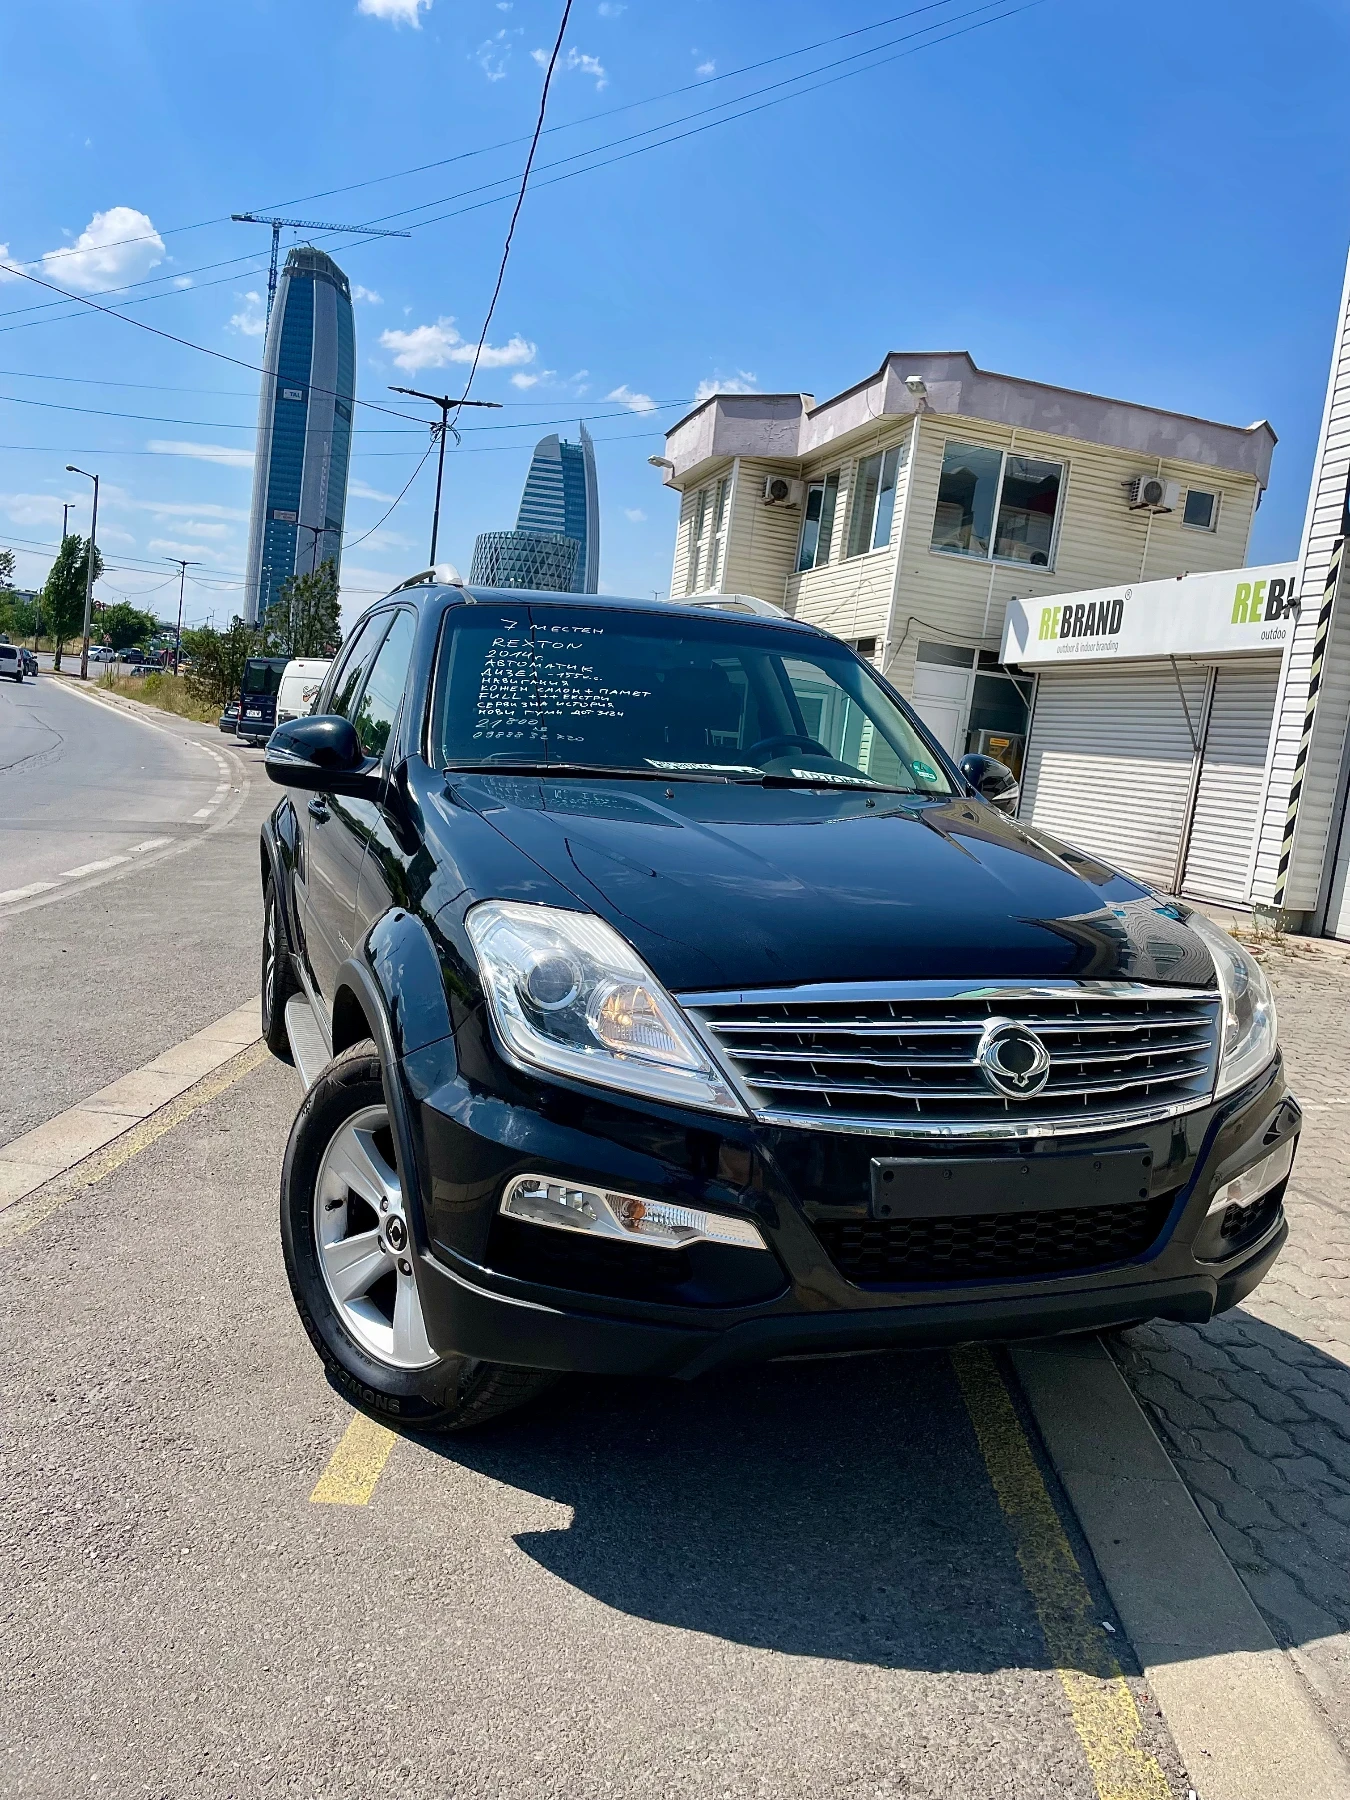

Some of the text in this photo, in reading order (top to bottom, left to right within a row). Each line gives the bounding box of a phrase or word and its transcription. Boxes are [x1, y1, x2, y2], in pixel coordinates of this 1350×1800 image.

[500, 618, 604, 635] 7 МЕСТЕН
[1039, 599, 1124, 640] REBRAND
[491, 637, 583, 649] REXTON
[1056, 643, 1075, 654] outdoor
[1080, 641, 1096, 653] indoor
[1096, 640, 1119, 653] branding
[480, 667, 538, 678] ДИЗЕЛ
[484, 658, 594, 673] АВТОМАТИК
[478, 692, 522, 701] FULL
[480, 684, 529, 693] КОЖЕН
[599, 688, 652, 698] ПАМЕТ
